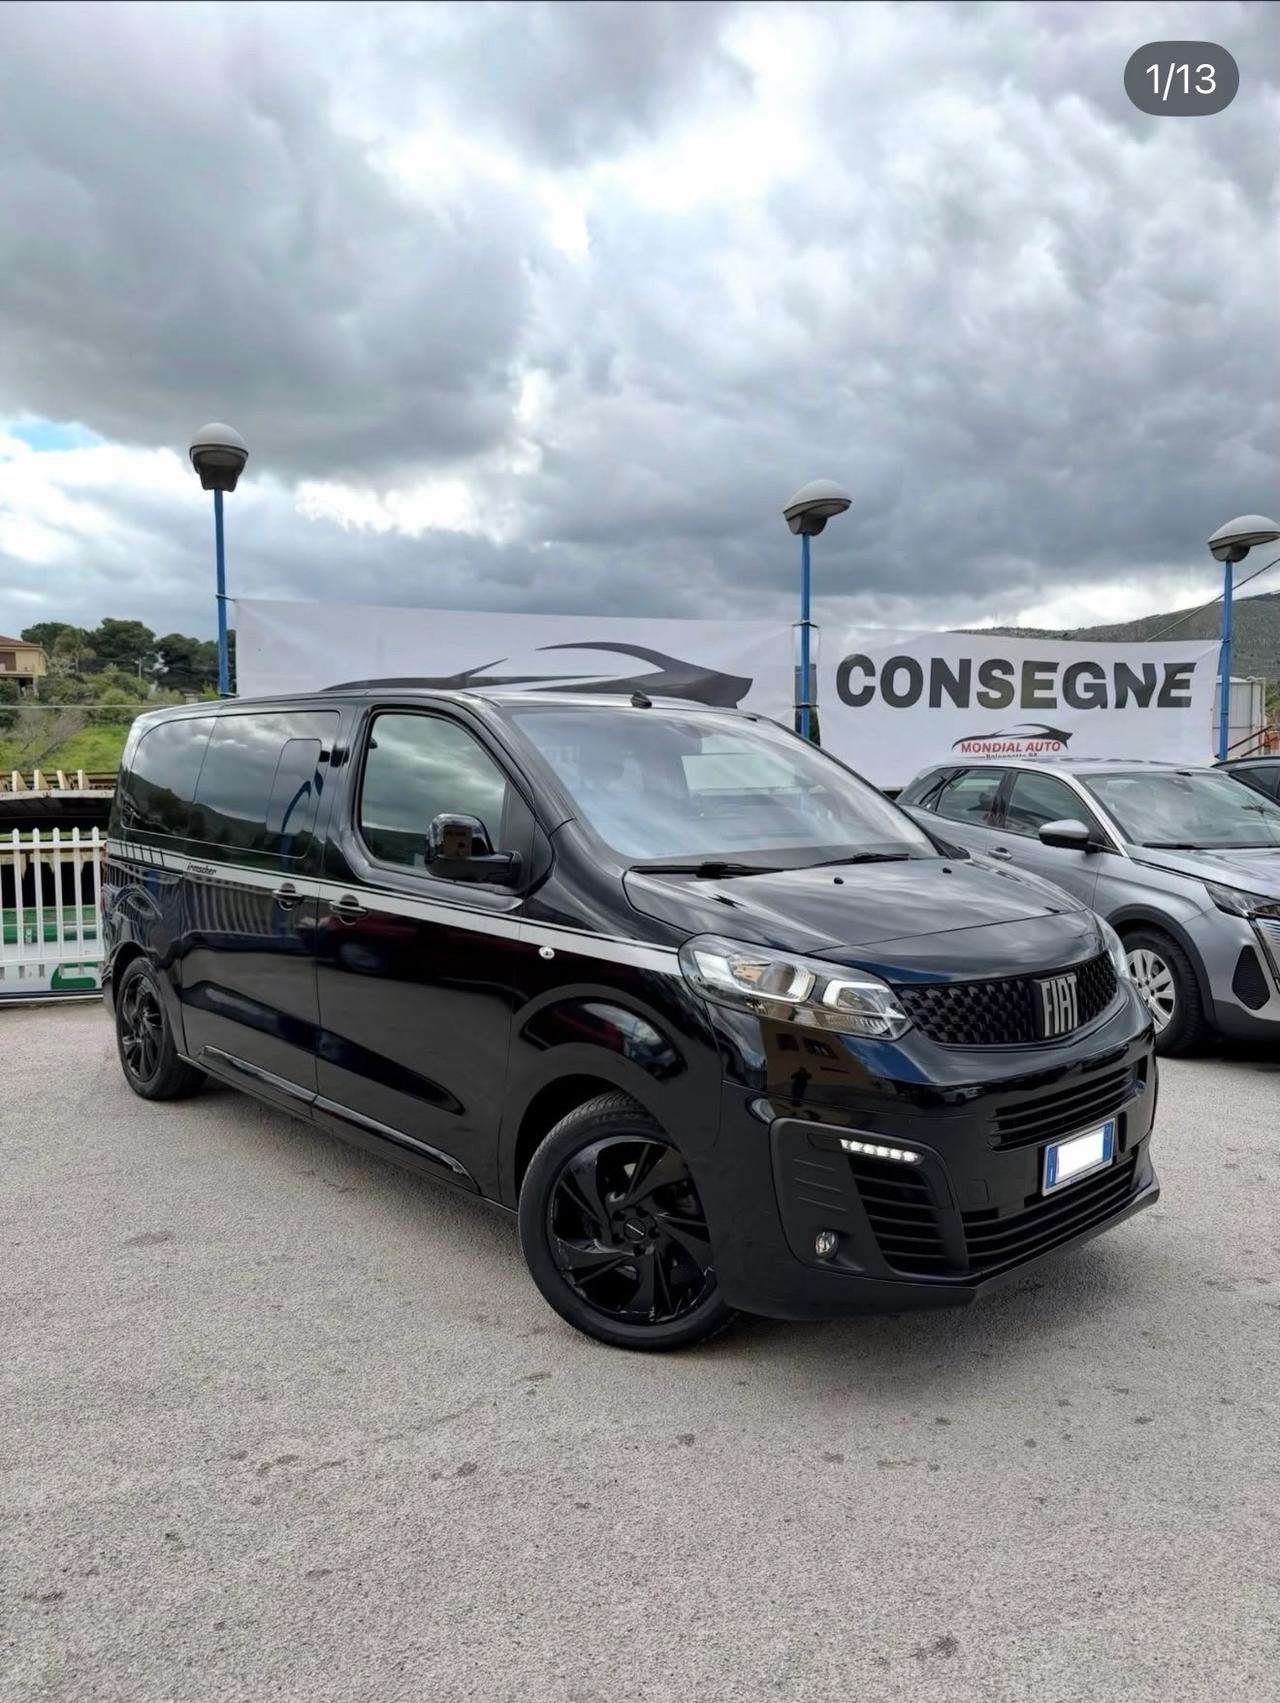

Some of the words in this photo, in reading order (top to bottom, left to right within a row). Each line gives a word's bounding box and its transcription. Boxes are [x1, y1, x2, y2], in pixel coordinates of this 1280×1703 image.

[836, 653, 1197, 710] CONSEGNE
[961, 742, 1023, 753] MONDIAL
[1025, 741, 1061, 752] AUTO
[1041, 975, 1078, 1038] FIAT
